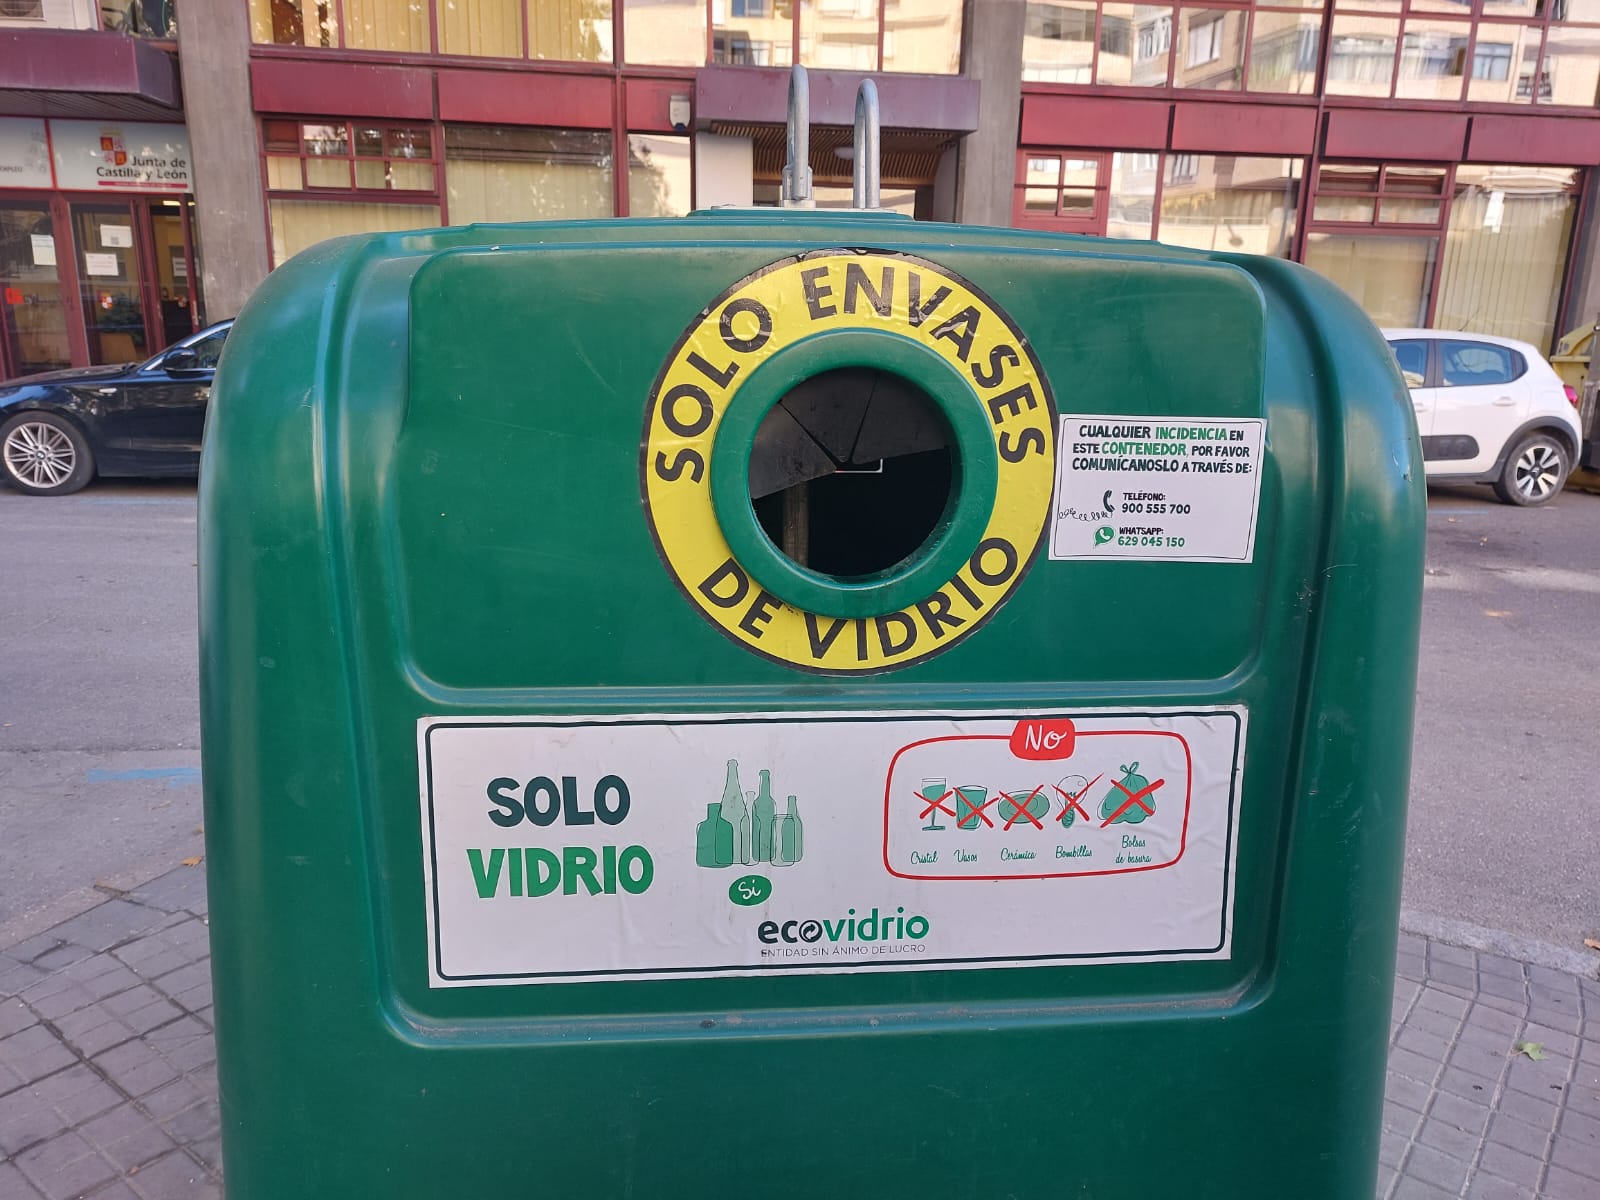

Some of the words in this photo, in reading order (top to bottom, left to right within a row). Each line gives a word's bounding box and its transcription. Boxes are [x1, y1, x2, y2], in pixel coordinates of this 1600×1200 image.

[131, 157, 166, 167] Junta
[170, 158, 186, 167] de
[96, 167, 140, 177] Castilla
[145, 170, 153, 180] y
[157, 168, 187, 179] León
[655, 298, 772, 484] SOLO
[800, 263, 1046, 464] ENVASES
[1079, 425, 1151, 438] CUALQUIER
[1155, 427, 1227, 440] INCIDENCIA
[1229, 430, 1244, 441] EN
[1073, 443, 1099, 453] ESTE
[1101, 442, 1189, 457] CONTENEDOR,
[1191, 445, 1212, 456] POR
[1215, 446, 1250, 457] FAVOR
[1072, 455, 1179, 472] COMUNÍCANOSLO
[1181, 462, 1190, 472] A
[1191, 459, 1233, 473] TRAVÉS
[1235, 463, 1252, 473] DE:
[1123, 490, 1166, 501] TELÉFONO:
[1122, 503, 1143, 513] 900
[1146, 503, 1166, 513] 555
[1170, 504, 1191, 514] 700
[1119, 527, 1164, 535] WHATSAPP:
[1118, 536, 1138, 546] 629
[1141, 536, 1163, 546] 045
[1166, 537, 1185, 547] 150
[697, 557, 784, 639] DE
[804, 537, 1018, 660] VIDRIO
[1025, 724, 1067, 751] No
[486, 774, 631, 828] SOLO
[1122, 834, 1146, 849] Bolsas
[910, 850, 939, 864] Cristal
[953, 849, 978, 862] Vasos
[1000, 847, 1037, 861] Cerámica
[1055, 845, 1093, 859] Bombillas
[1115, 852, 1125, 864] de
[1127, 852, 1152, 863] basura
[466, 844, 655, 899] VIDRIO
[757, 906, 930, 944] ecovidrio
[761, 948, 809, 958] ENTIDAD
[811, 947, 829, 956] SIN
[832, 944, 869, 955] ÁNIMO
[872, 946, 886, 954] DE
[889, 944, 926, 954] LUCRO
